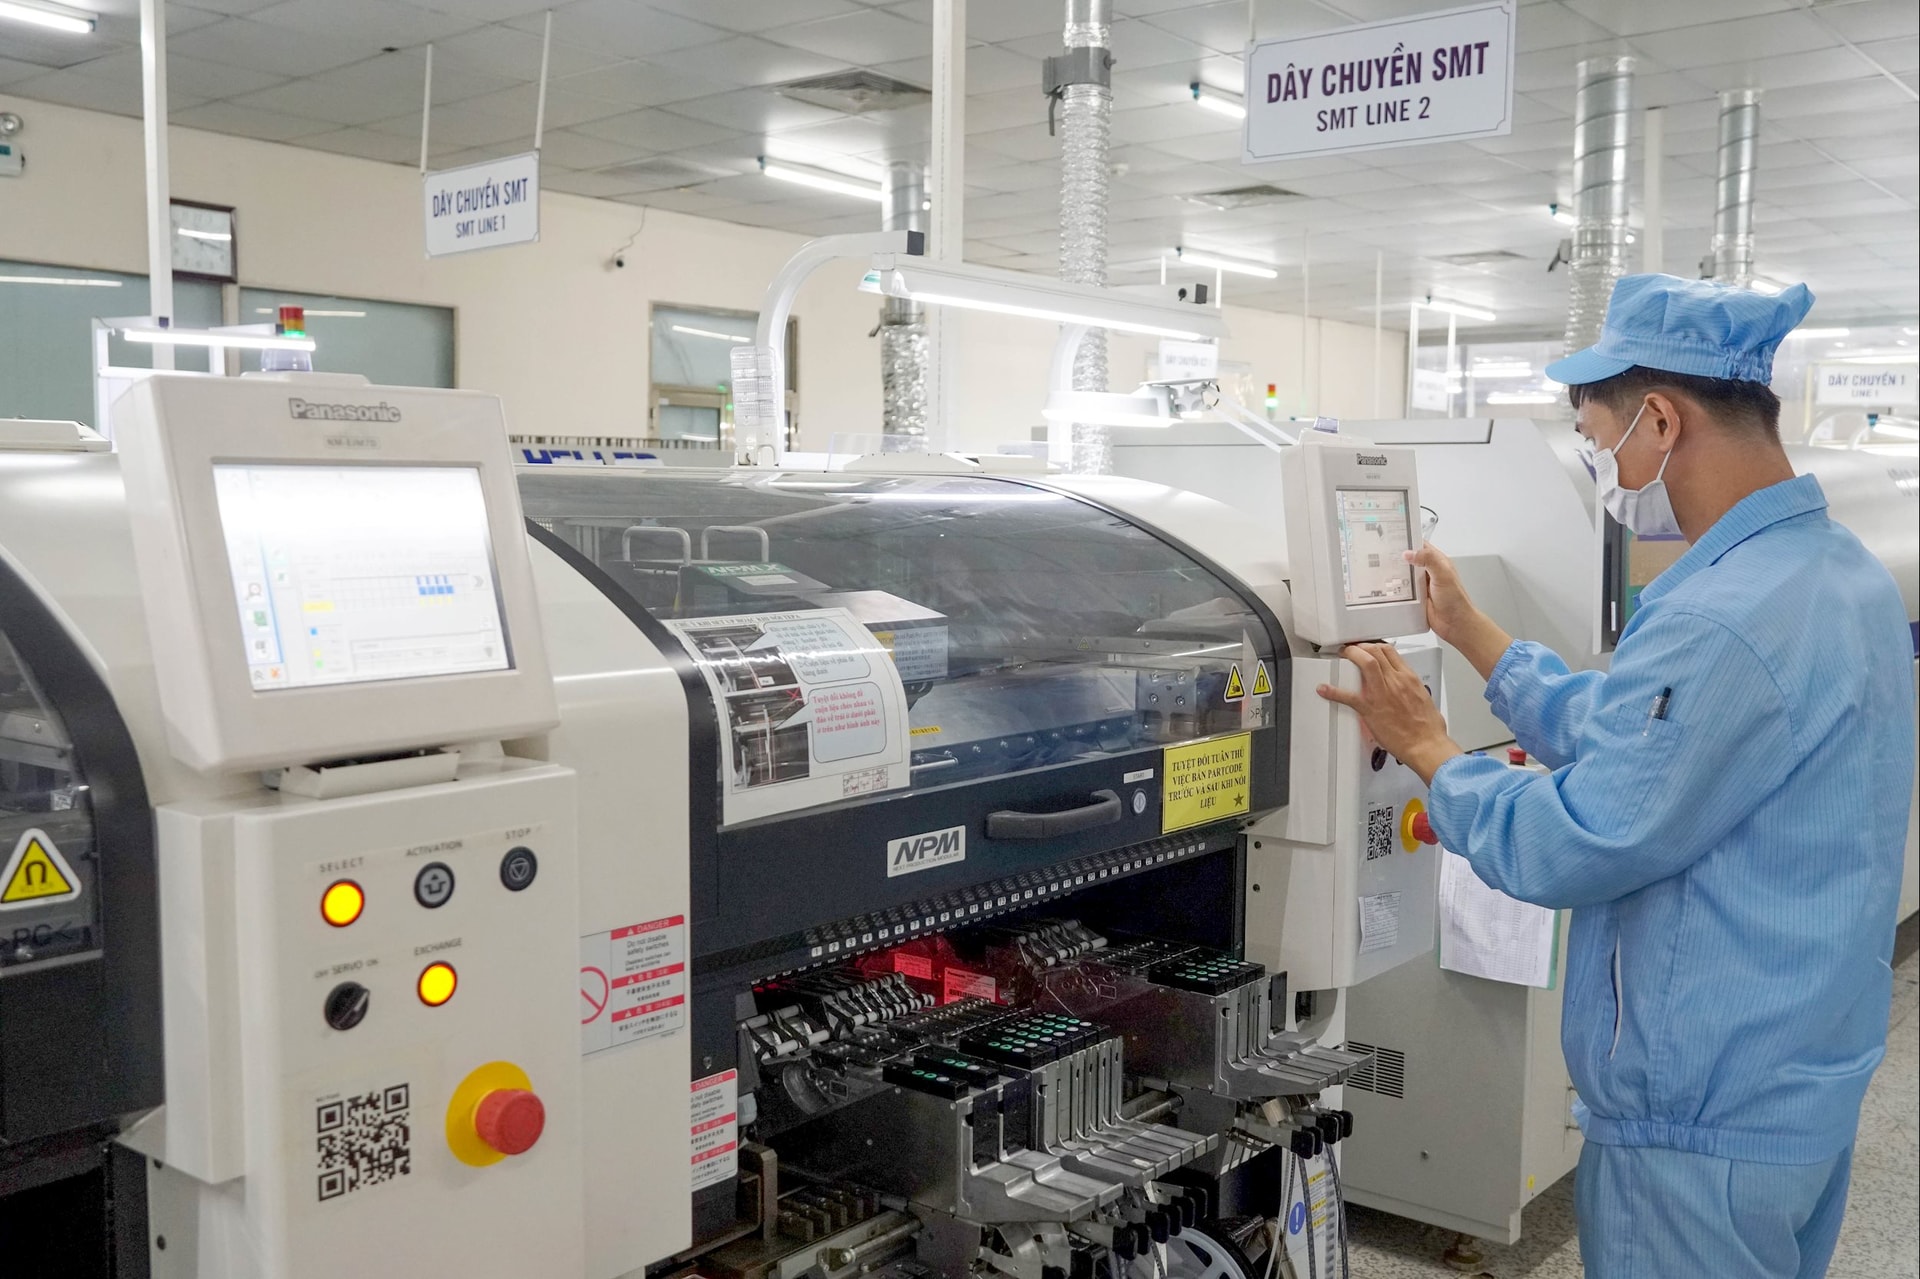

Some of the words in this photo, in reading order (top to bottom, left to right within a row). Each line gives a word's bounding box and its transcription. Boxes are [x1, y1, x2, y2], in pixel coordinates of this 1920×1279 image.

[1267, 62, 1313, 104] DÂY
[1321, 42, 1422, 96] CHUYỀN
[1432, 41, 1490, 81] SMT
[1316, 106, 1358, 132] SMT
[1366, 98, 1411, 126] LINE
[1418, 96, 1431, 120] 2
[433, 189, 453, 218] DÂY
[503, 177, 528, 205] SMT
[456, 220, 474, 239] SMT
[478, 215, 499, 234] LINE
[501, 214, 506, 230] 1
[288, 397, 401, 422] Panasonic
[1356, 453, 1387, 466] Panasonic
[1172, 758, 1196, 772] TUYỆT
[1198, 753, 1210, 766] ĐỐI
[1212, 751, 1229, 763] TUÂN
[1231, 746, 1245, 759] THỦ
[1172, 773, 1190, 786] VIỆC
[1208, 762, 1243, 778] PARTCODE
[1168, 786, 1195, 802] TRƯỚC
[1196, 783, 1205, 795] VÀ
[1207, 781, 1220, 792] SAU
[1221, 778, 1233, 790] KHI
[1234, 774, 1246, 785] NỐI
[1200, 796, 1216, 809] LIỆU
[505, 828, 531, 840] STOP
[406, 840, 463, 857] ACTIVATION
[894, 830, 959, 865] NPM
[319, 857, 364, 873] SELECT
[906, 858, 936, 868] PRODUCTION
[637, 919, 669, 933] DANGER
[414, 938, 462, 956] EXCHANGE
[627, 940, 635, 948] Do
[637, 938, 646, 946] not
[647, 934, 666, 943] disable
[627, 947, 643, 956] safety
[646, 941, 669, 951] switches
[332, 960, 362, 975] SERVO
[695, 1075, 723, 1090] DANGER
